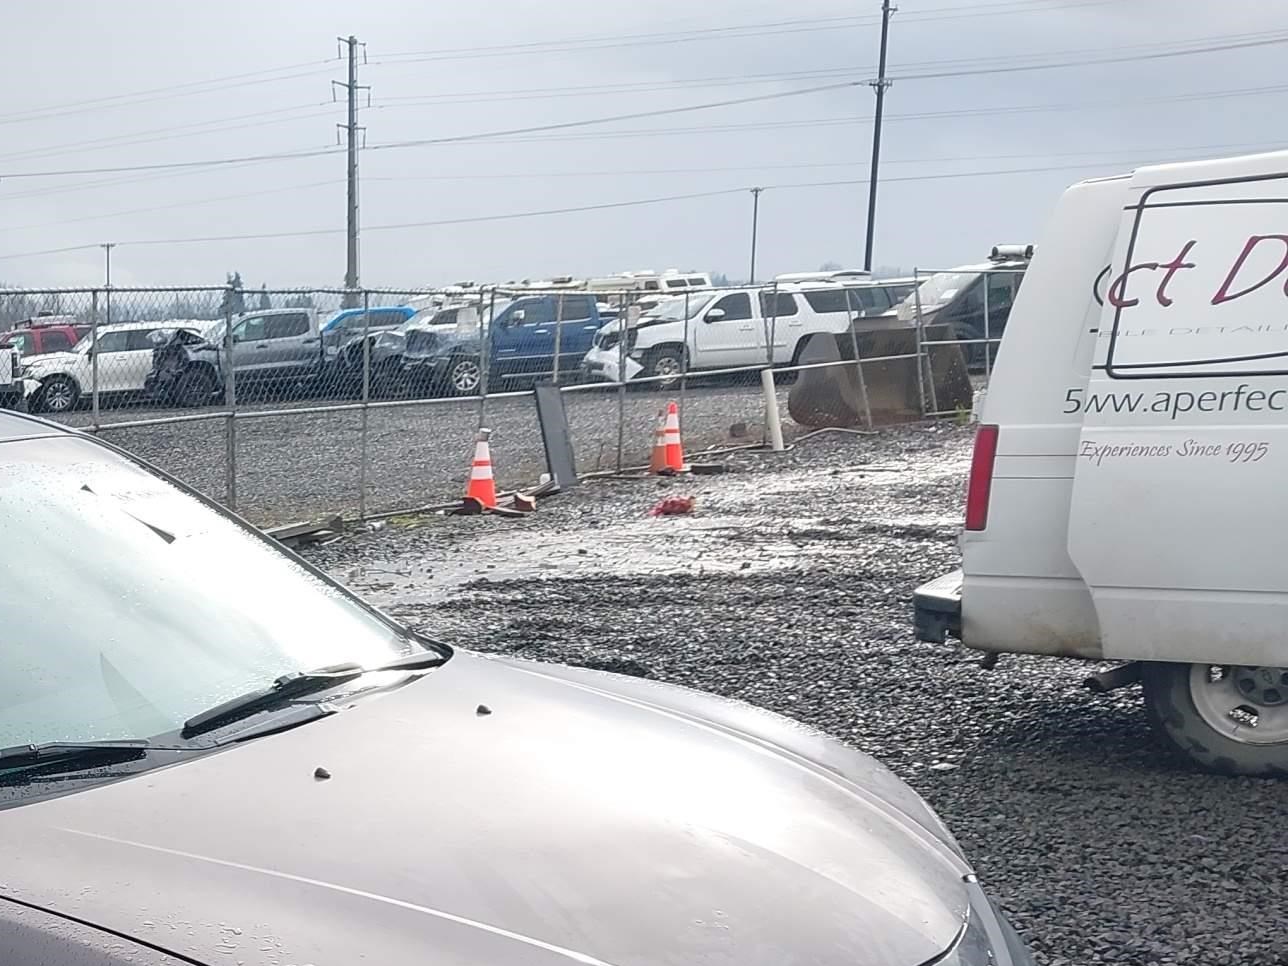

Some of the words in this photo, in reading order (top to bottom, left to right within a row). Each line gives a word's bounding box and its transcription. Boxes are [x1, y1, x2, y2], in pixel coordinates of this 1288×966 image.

[1080, 440, 1173, 466] Experiences
[1176, 439, 1222, 457] Since
[1226, 441, 1270, 463] 1995
